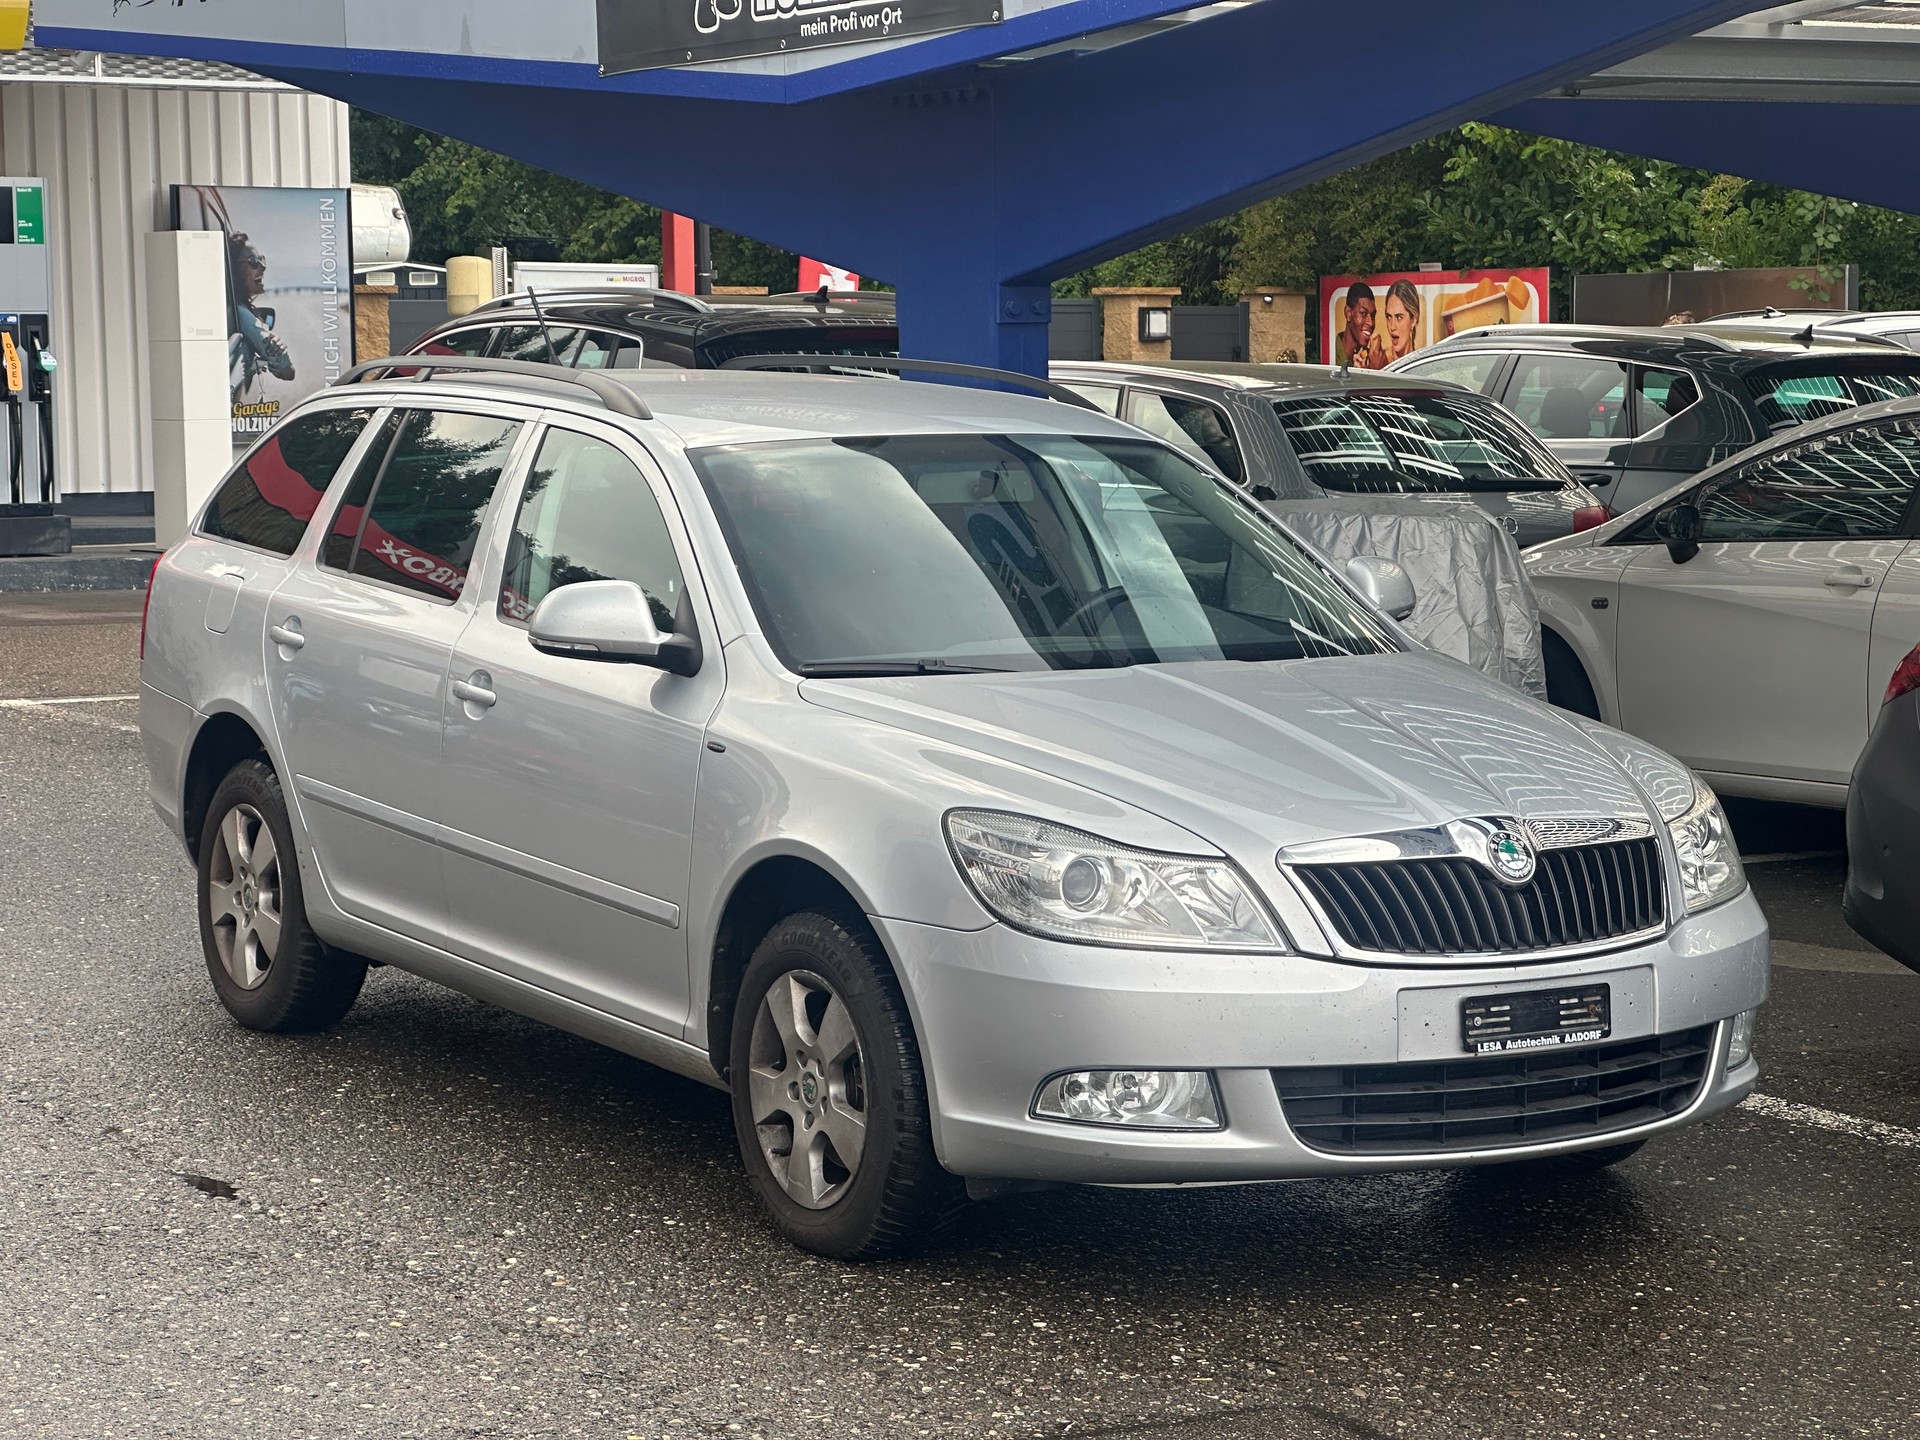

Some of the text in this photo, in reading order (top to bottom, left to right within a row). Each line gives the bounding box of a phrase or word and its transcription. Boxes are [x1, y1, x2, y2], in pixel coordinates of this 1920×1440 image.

[800, 17, 828, 37] mein
[829, 11, 858, 33] Profi
[859, 13, 880, 28] vor
[881, 7, 902, 24] Ort
[320, 198, 338, 332] WILLKOMMEN
[6, 343, 17, 386] DIESEL
[232, 400, 279, 419] Garage
[1477, 1030, 1602, 1052] LESA Autotechnik AADORF
